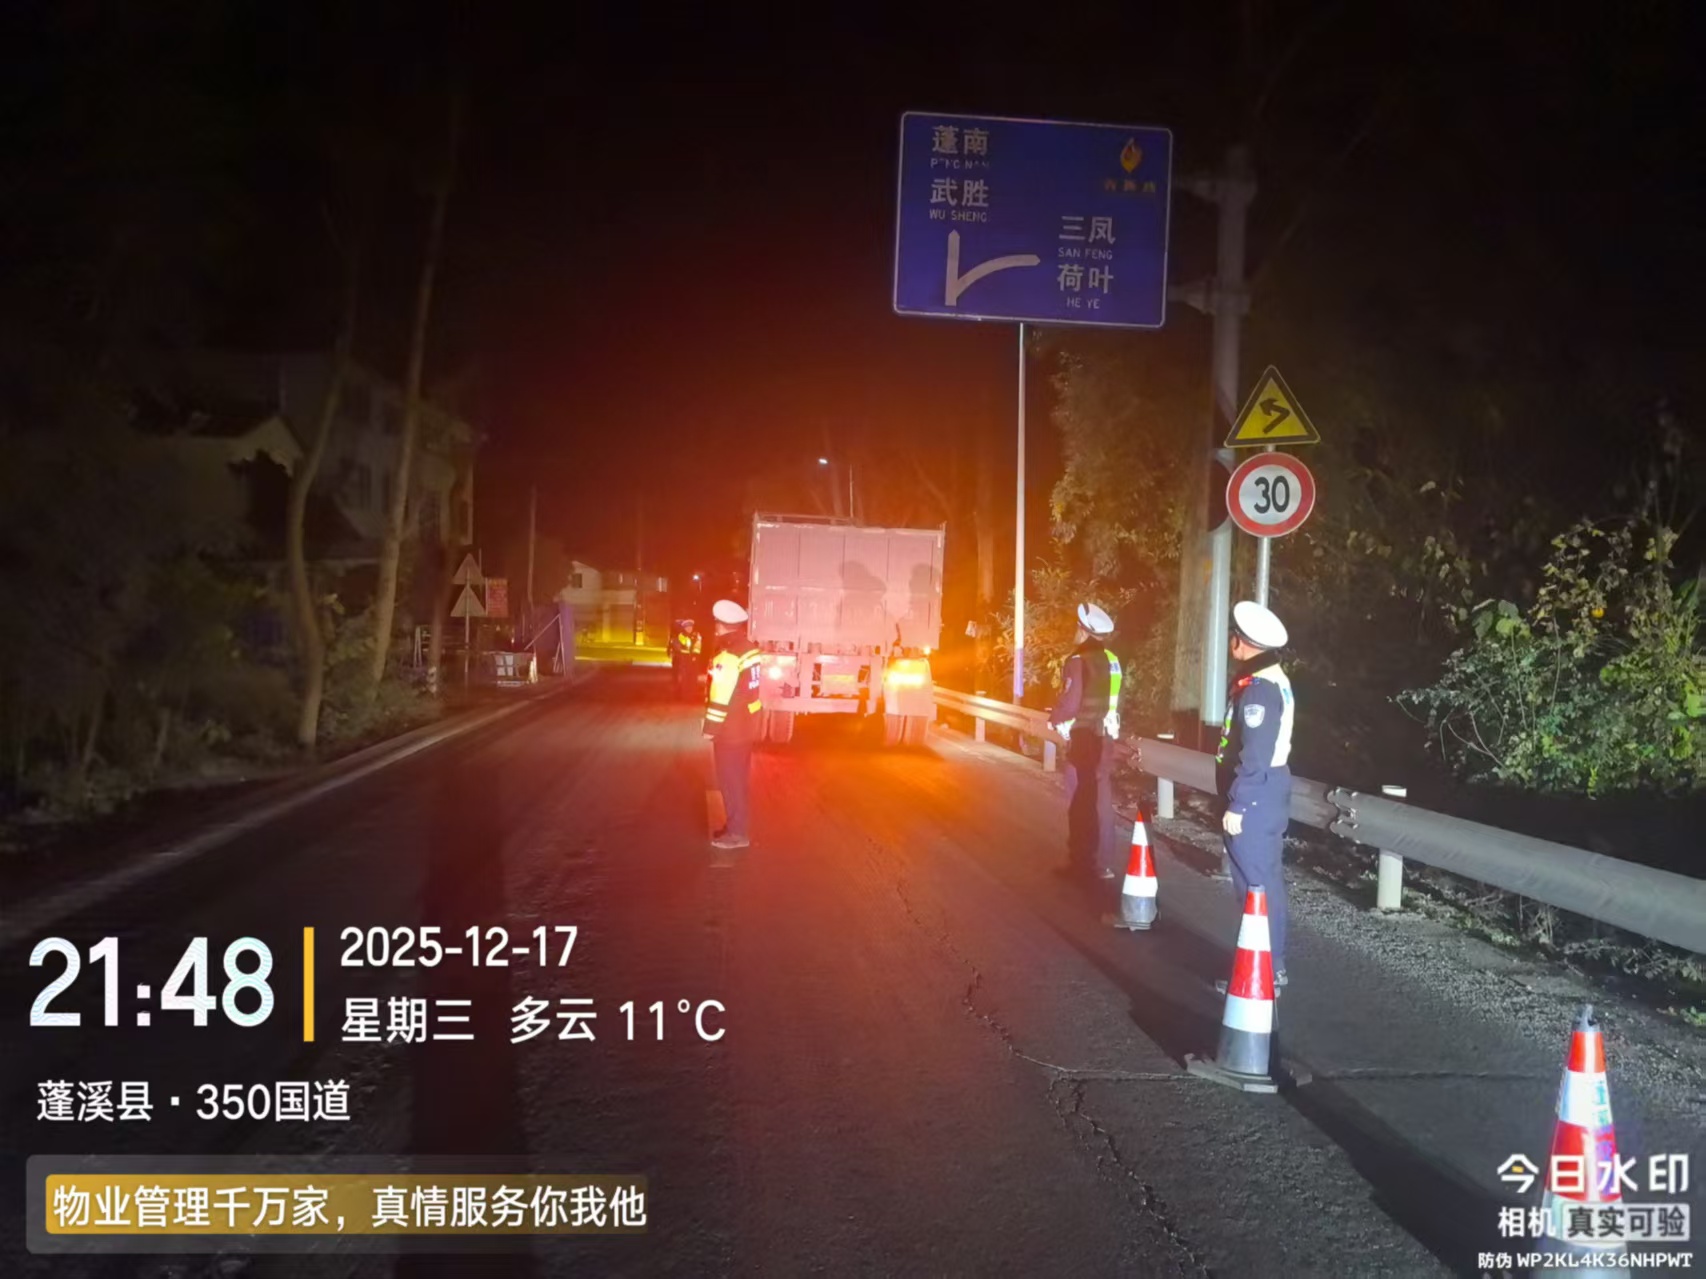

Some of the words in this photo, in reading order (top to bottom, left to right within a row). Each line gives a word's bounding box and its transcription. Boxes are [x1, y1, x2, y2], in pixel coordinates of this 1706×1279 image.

[931, 125, 990, 156] 蓬南
[929, 177, 990, 207] 武胜
[929, 209, 946, 221] WU
[951, 210, 988, 222] SHENG
[1058, 215, 1116, 244] 三凤
[1058, 247, 1081, 258] SAN
[1085, 248, 1113, 260] FENG
[1057, 264, 1114, 294] 荷叶
[1066, 297, 1081, 308] HE
[1087, 298, 1101, 309] YE
[1254, 475, 1290, 514] 30
